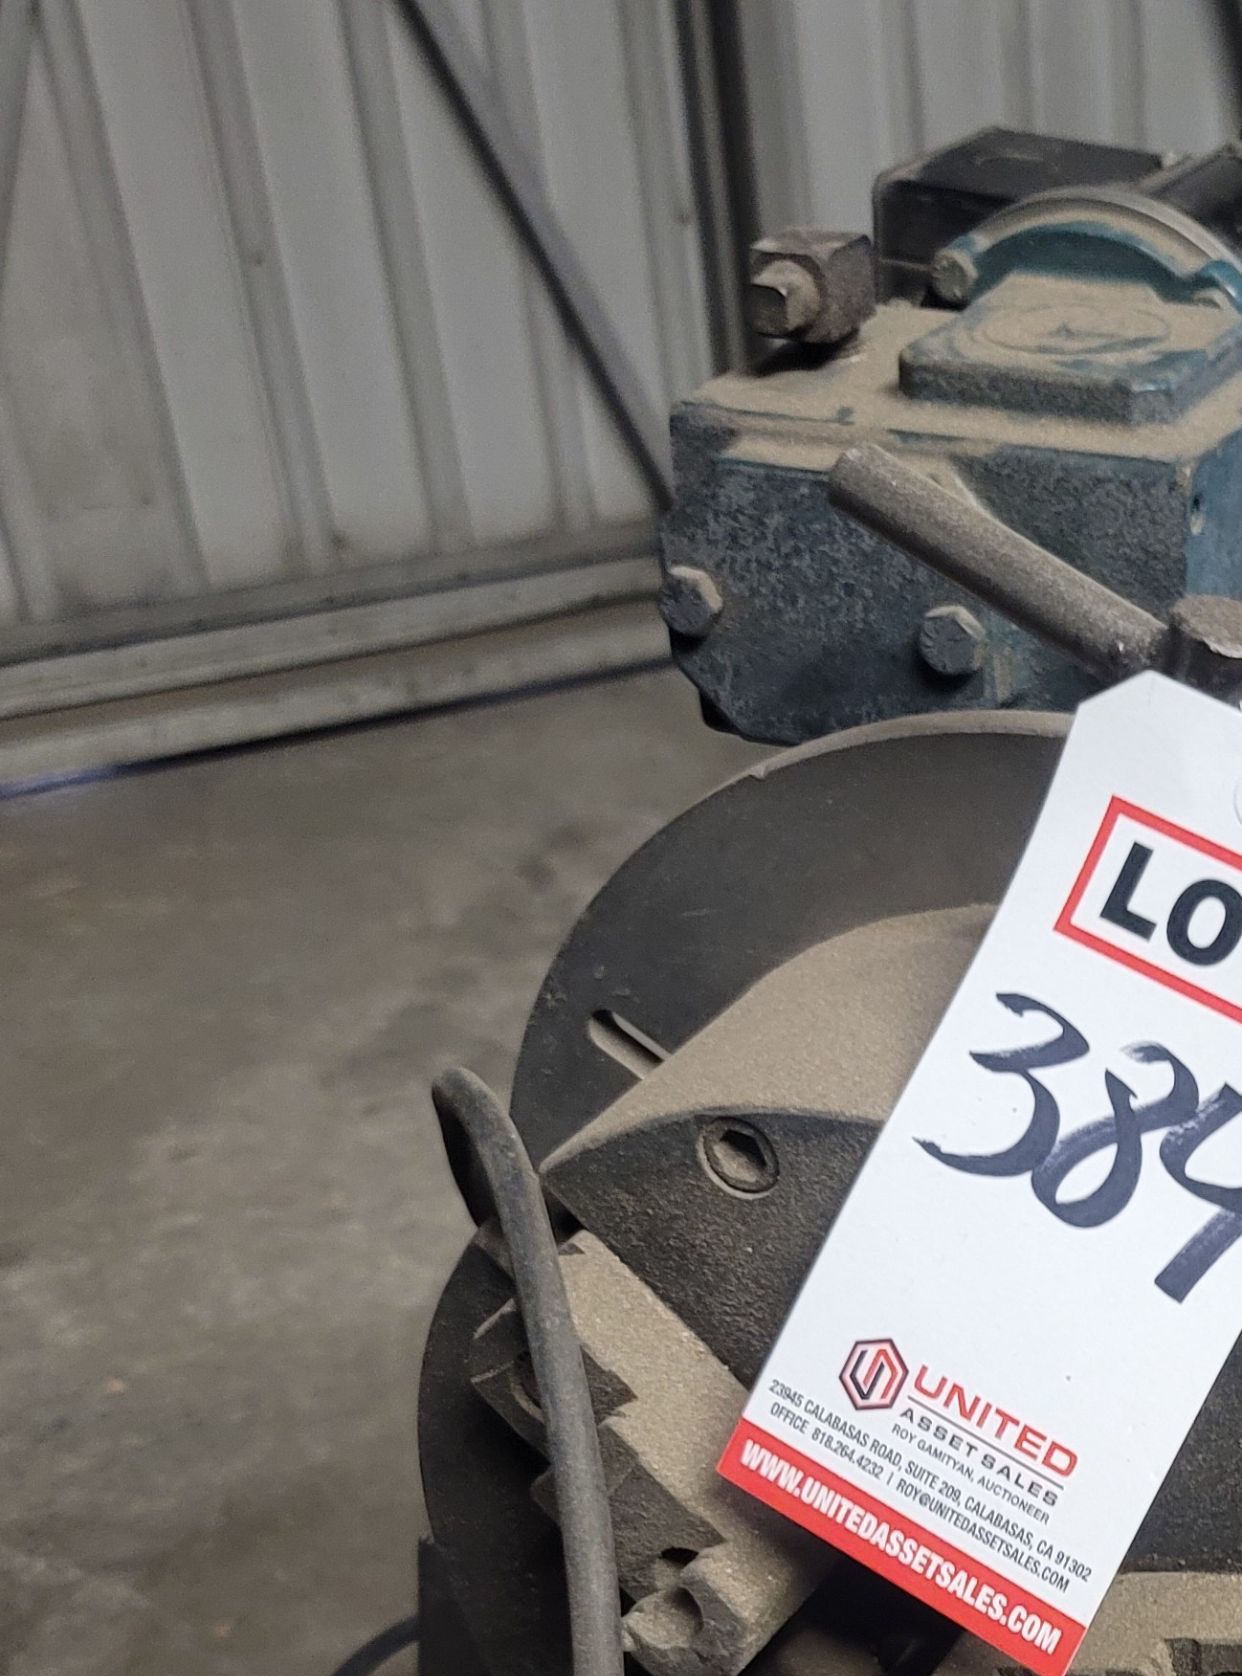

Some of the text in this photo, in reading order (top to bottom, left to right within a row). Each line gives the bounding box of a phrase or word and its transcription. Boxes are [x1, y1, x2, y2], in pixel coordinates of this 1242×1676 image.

[768, 1379, 1092, 1582] 23945 CALABASAS ROAD, SUITE 209, CALABASAS, CA 91302
[891, 1423, 1050, 1526] ROY GAMITYAN, AUCTIONEER
[900, 1407, 1059, 1508] ASSET SALES
[914, 1364, 1078, 1478] UNITED
[740, 1438, 1062, 1655] WWW.UNITEDASSETSALES.COM
[770, 1402, 810, 1434] OFFICE
[811, 1427, 884, 1479] 818.264.4232
[896, 1478, 1070, 1593] ROY@UNITEDASSETSALES.COM
